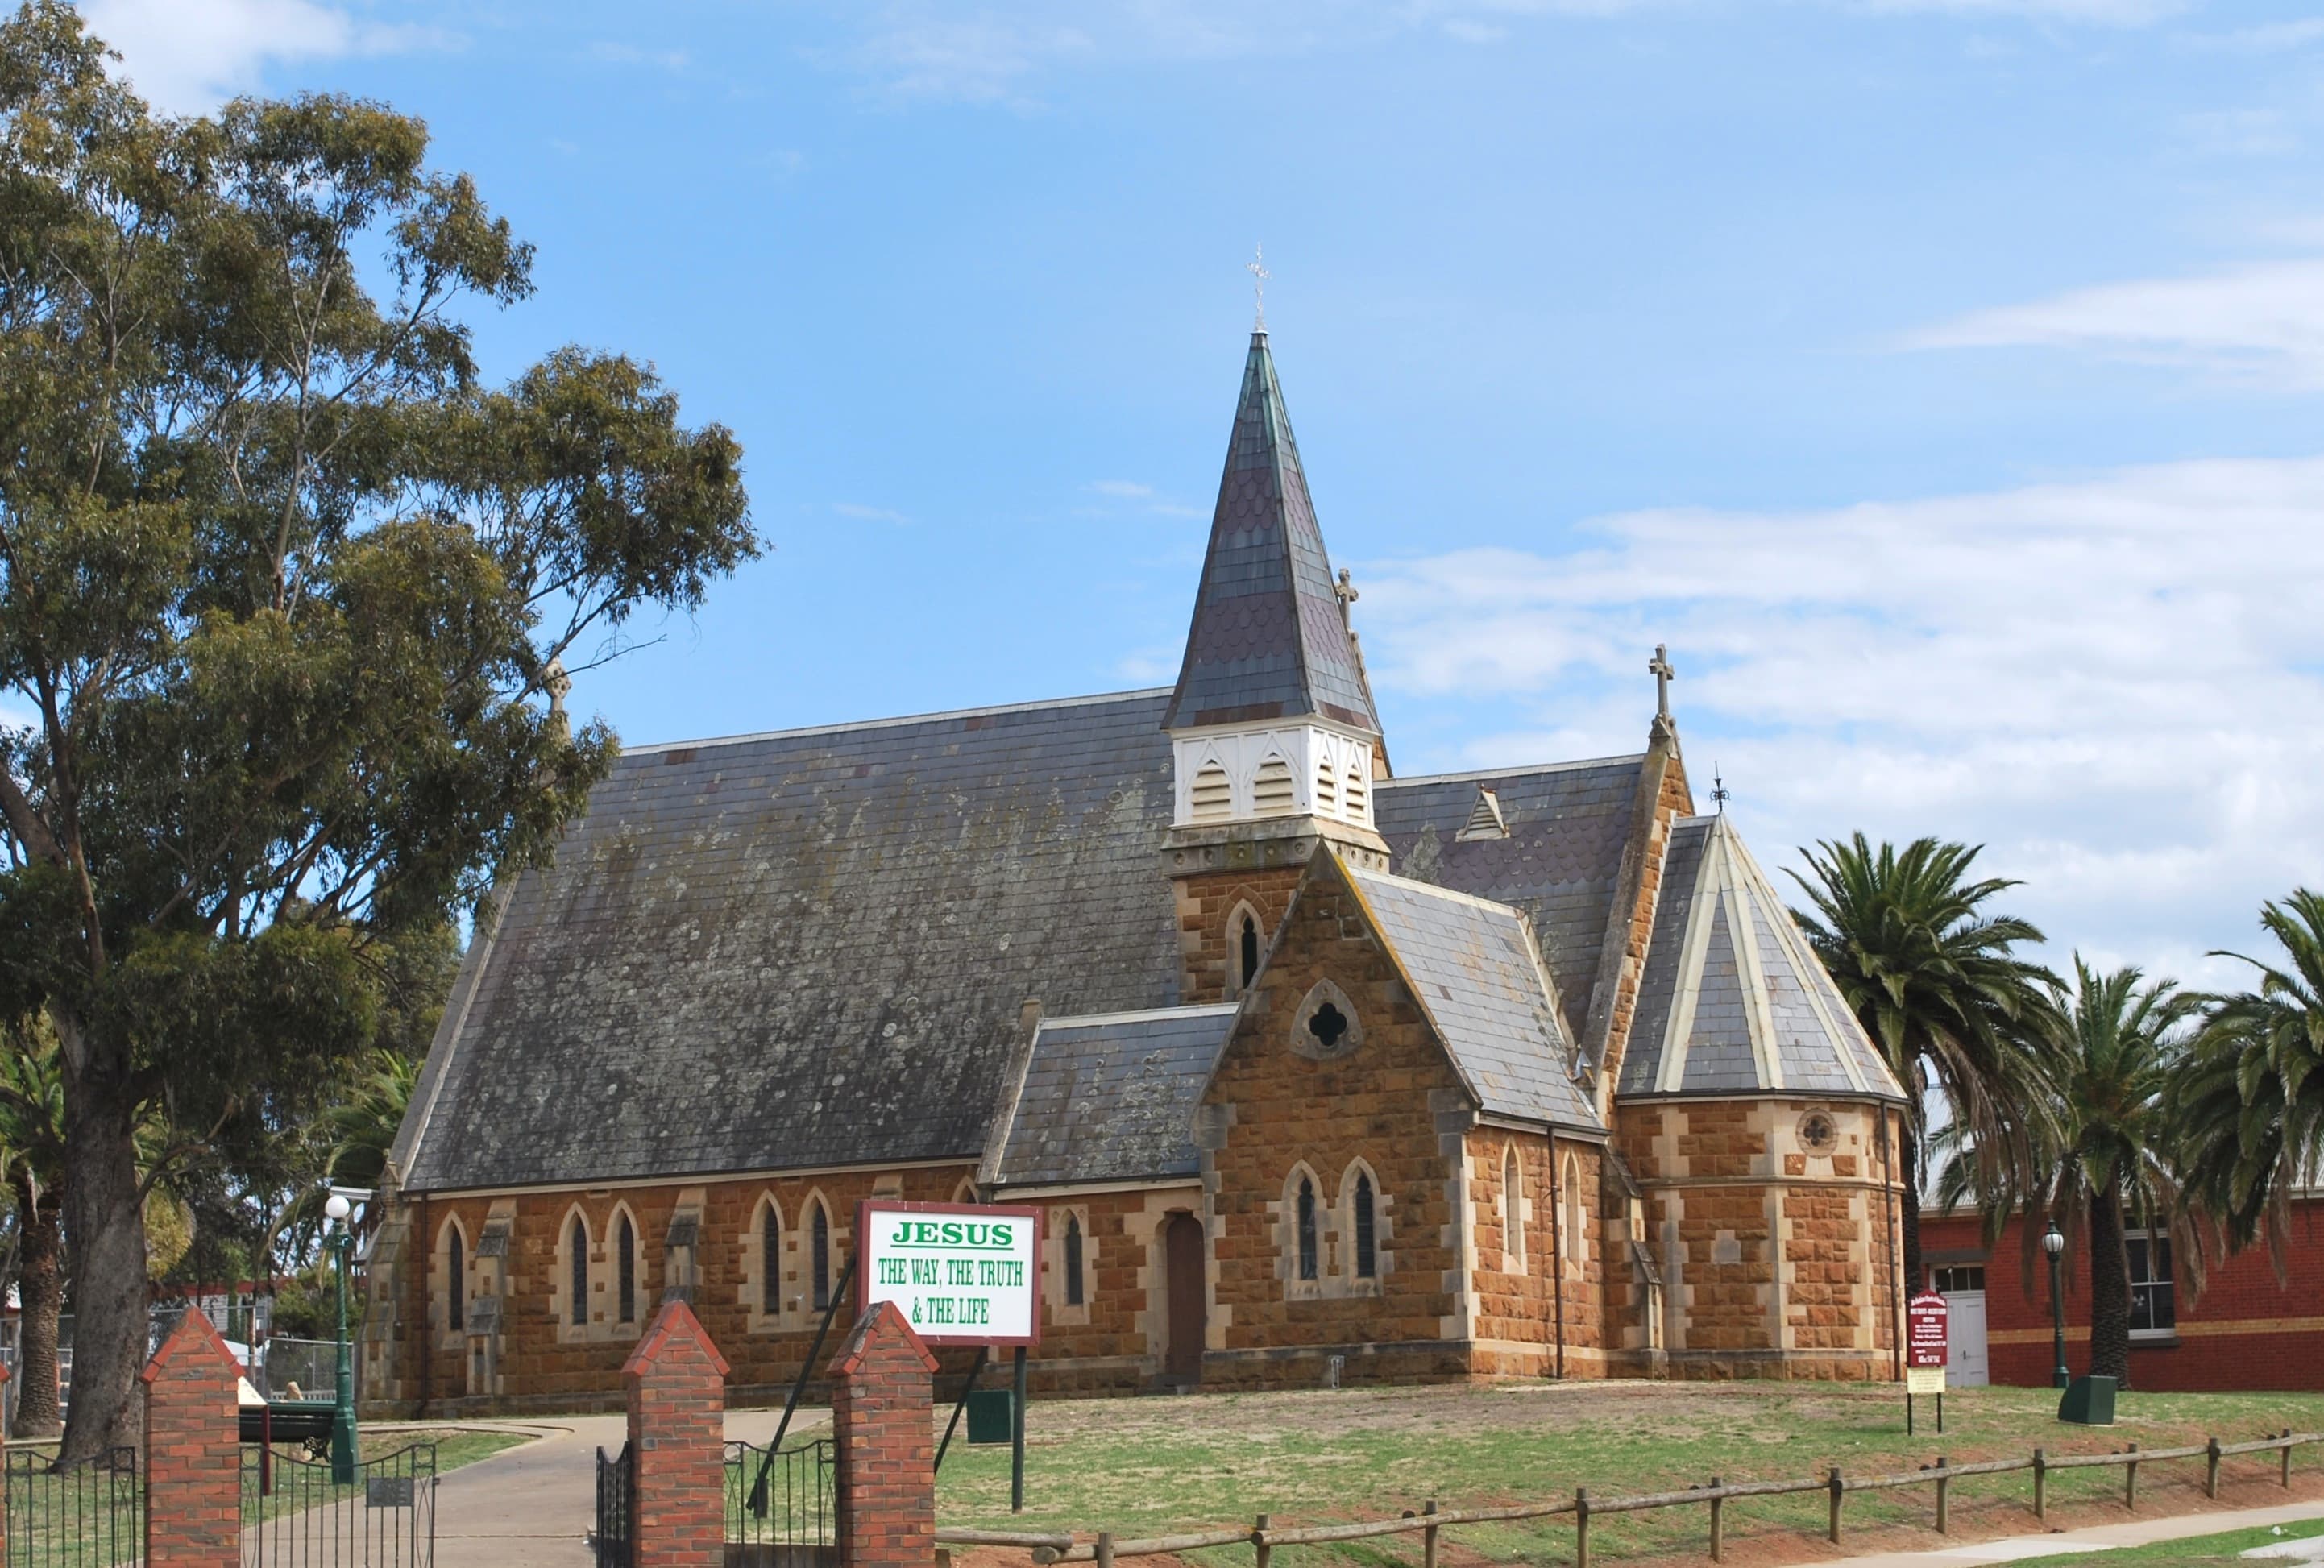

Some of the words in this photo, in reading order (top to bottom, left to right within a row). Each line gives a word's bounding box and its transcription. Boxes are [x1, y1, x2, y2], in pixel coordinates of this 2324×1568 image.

[892, 1222, 1013, 1247] JESUS
[878, 1258, 907, 1284] THE
[911, 1259, 942, 1289] WAY,
[946, 1259, 974, 1286] THE
[978, 1260, 1023, 1287] TRUTH
[911, 1296, 923, 1324] &
[927, 1297, 955, 1324] THE
[958, 1298, 990, 1324] LIFE
